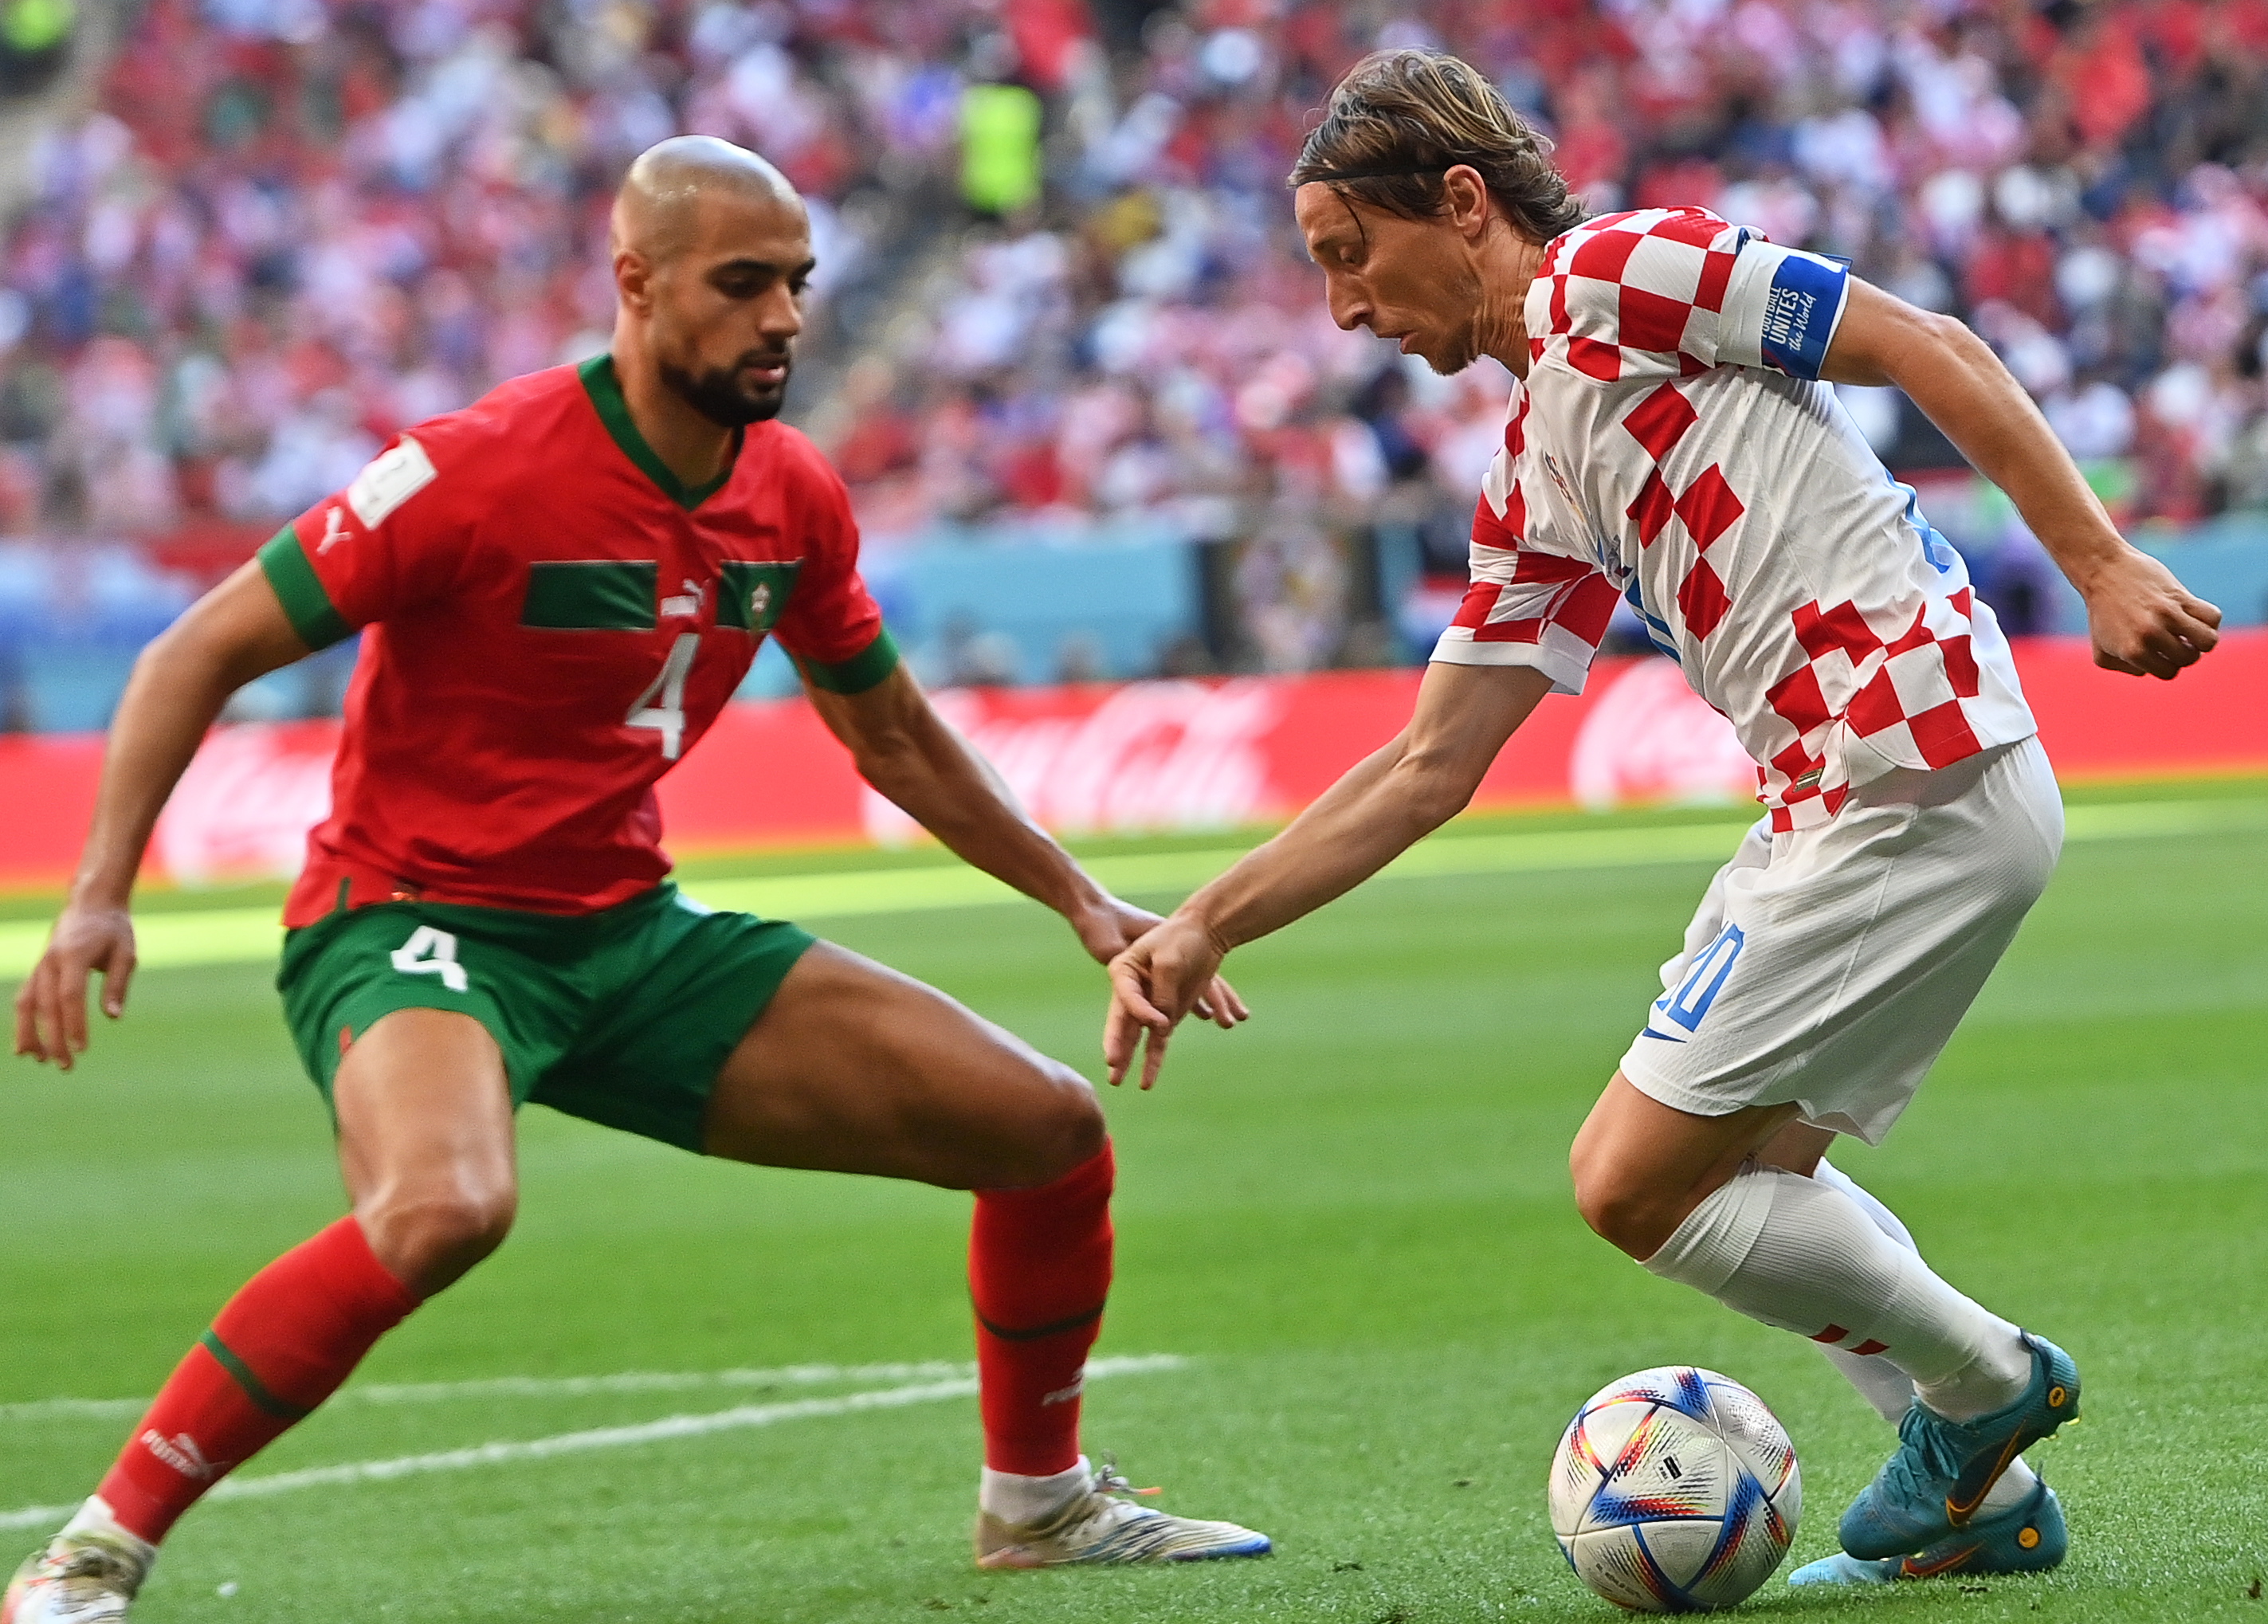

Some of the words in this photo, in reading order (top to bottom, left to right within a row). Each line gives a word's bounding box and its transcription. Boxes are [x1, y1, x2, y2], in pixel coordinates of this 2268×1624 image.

[1768, 288, 1799, 345] UNITES
[1793, 292, 1817, 331] World
[1789, 331, 1803, 351] the
[625, 633, 701, 760] 4
[390, 924, 469, 992] 4
